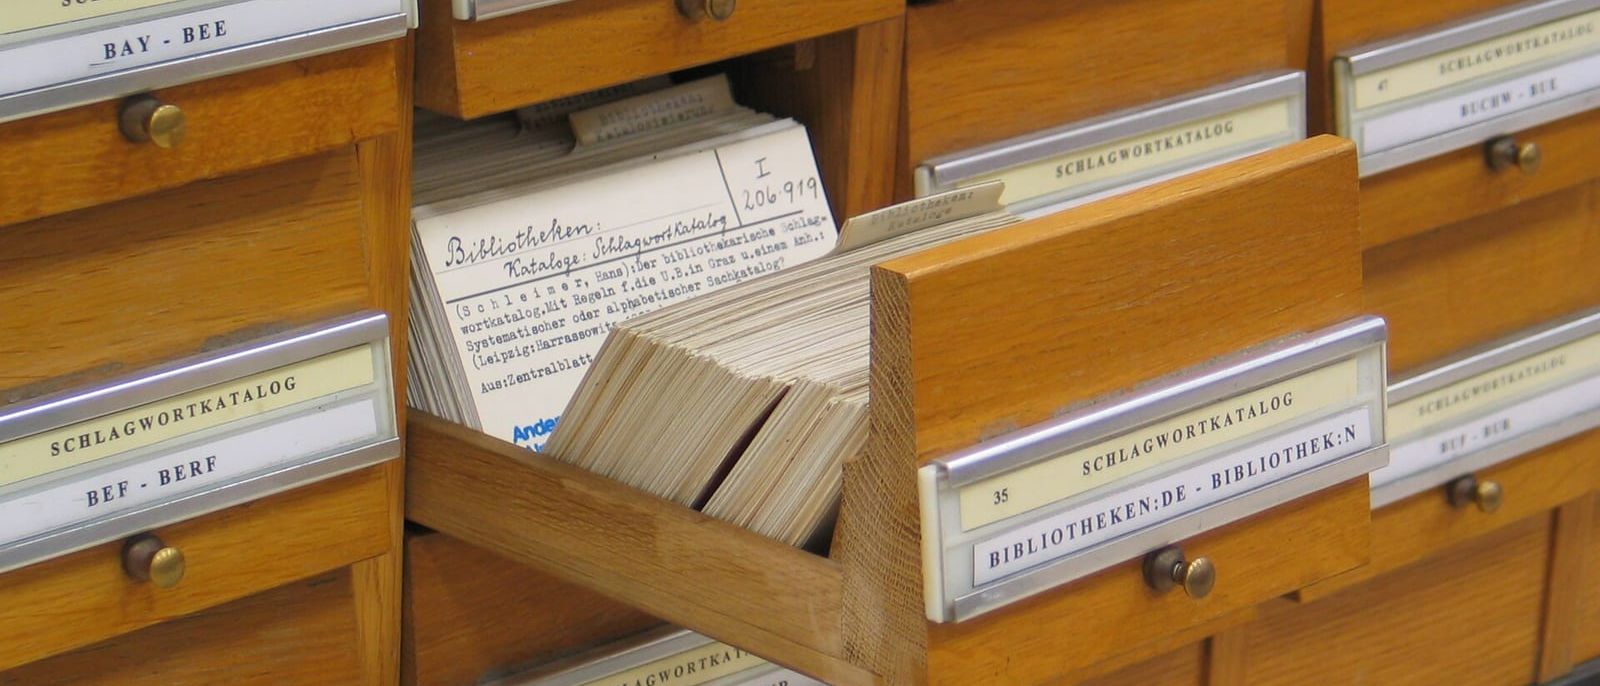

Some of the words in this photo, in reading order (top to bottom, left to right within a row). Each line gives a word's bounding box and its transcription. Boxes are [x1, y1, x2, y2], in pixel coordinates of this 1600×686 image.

[104, 34, 152, 60] BAY
[183, 19, 228, 45] BEE
[1438, 22, 1595, 75] SCHLAGWORTKATALOG
[1460, 91, 1511, 118] BUCHW
[1056, 119, 1234, 179] SCHLAGWORTKATALOG
[445, 218, 601, 268] Bibliotheken:
[503, 251, 587, 277] Kataloge:
[662, 227, 776, 264] bibliothekarische
[572, 284, 616, 306] Regeln
[707, 255, 736, 270] Graz
[466, 318, 566, 353] Systematischer
[572, 309, 601, 323] oder
[606, 281, 702, 314] alphabetischer
[1418, 354, 1567, 416] SCHLAGWORTKATALOG
[51, 376, 298, 457] SCHLAGWORTKATALOG
[1082, 391, 1295, 477] SCHLAGWORTKATALOG
[87, 480, 129, 508] BEF
[159, 455, 219, 486] BERF
[989, 484, 1187, 570] BIBLIOTHEKEN:DE
[1211, 423, 1358, 490] BIBLIOTHEK:N
[993, 487, 1009, 506] 35
